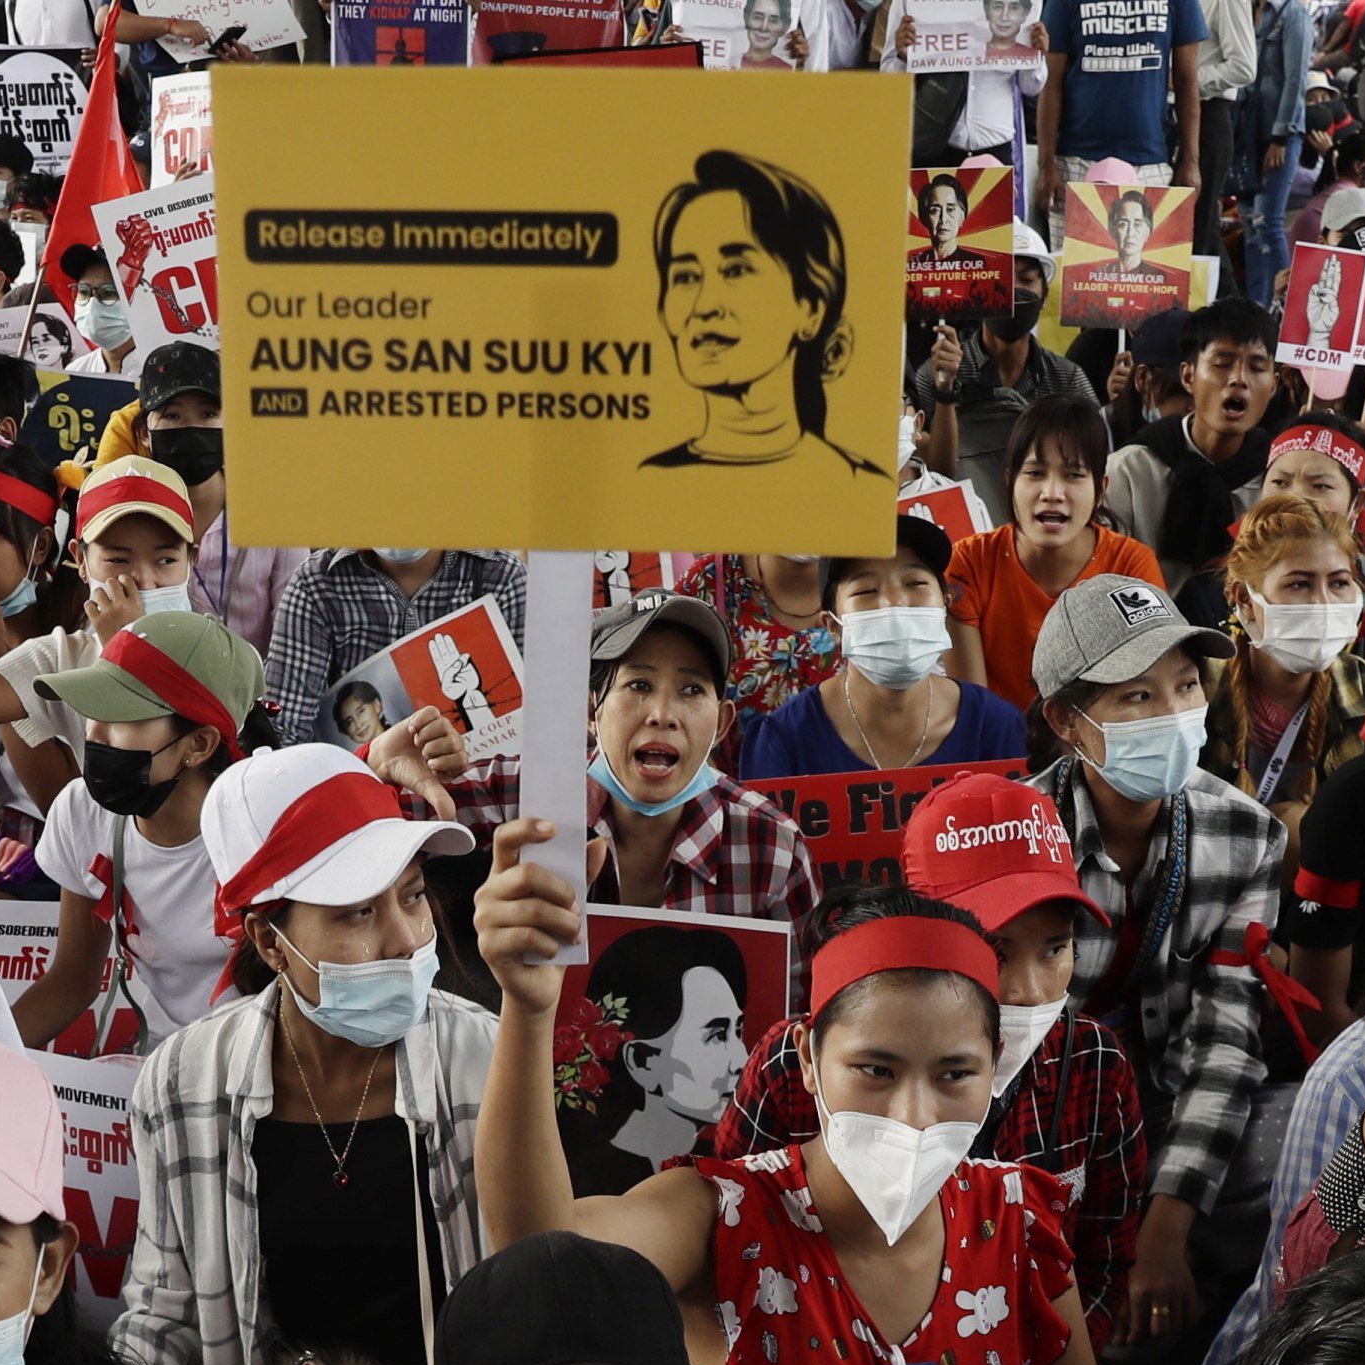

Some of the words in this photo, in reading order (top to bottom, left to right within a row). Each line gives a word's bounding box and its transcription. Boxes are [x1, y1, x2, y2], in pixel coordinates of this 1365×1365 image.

[338, 6, 366, 20] THEY
[370, 7, 411, 20] KIDNAP
[414, 8, 427, 21] AT
[429, 8, 464, 23] NIGHT
[535, 5, 571, 18] PEOPLE
[575, 8, 588, 19] AT
[590, 9, 620, 21] NIGHT
[1080, 0, 1169, 18] INSTALLING
[1081, 15, 1168, 36] MUSCLES
[912, 33, 969, 53] FREE
[1084, 44, 1124, 56] Please
[911, 57, 938, 69] DAW
[940, 55, 972, 67] AUNG
[143, 207, 166, 220] CIVIL
[257, 220, 385, 251] Release
[392, 220, 603, 261] Immediately
[934, 259, 961, 272] SAVE
[962, 258, 984, 271] OUR
[905, 270, 923, 283] DER
[928, 270, 968, 282] FUTURE
[971, 269, 1001, 281] HOPE
[1088, 271, 1120, 284] PLEASE
[1120, 271, 1144, 284] SAVE
[1144, 273, 1165, 285] OUR
[1072, 281, 1109, 293] LEADER
[1112, 282, 1150, 294] FUTURE
[1152, 284, 1179, 295] HOPE
[246, 291, 306, 321] Our
[315, 290, 433, 321] Leader
[249, 337, 377, 373] AUNG
[385, 339, 472, 373] SAN
[483, 339, 570, 375] SUU
[582, 340, 652, 376] KYI
[1294, 346, 1342, 366] #CDM
[257, 392, 303, 414] AND
[319, 390, 486, 419] ARRESTED
[496, 391, 652, 421] PERSONS
[1128, 606, 1169, 624] adidas
[478, 715, 512, 737] COUP
[52, 1084, 128, 1112] MOVEMENT
